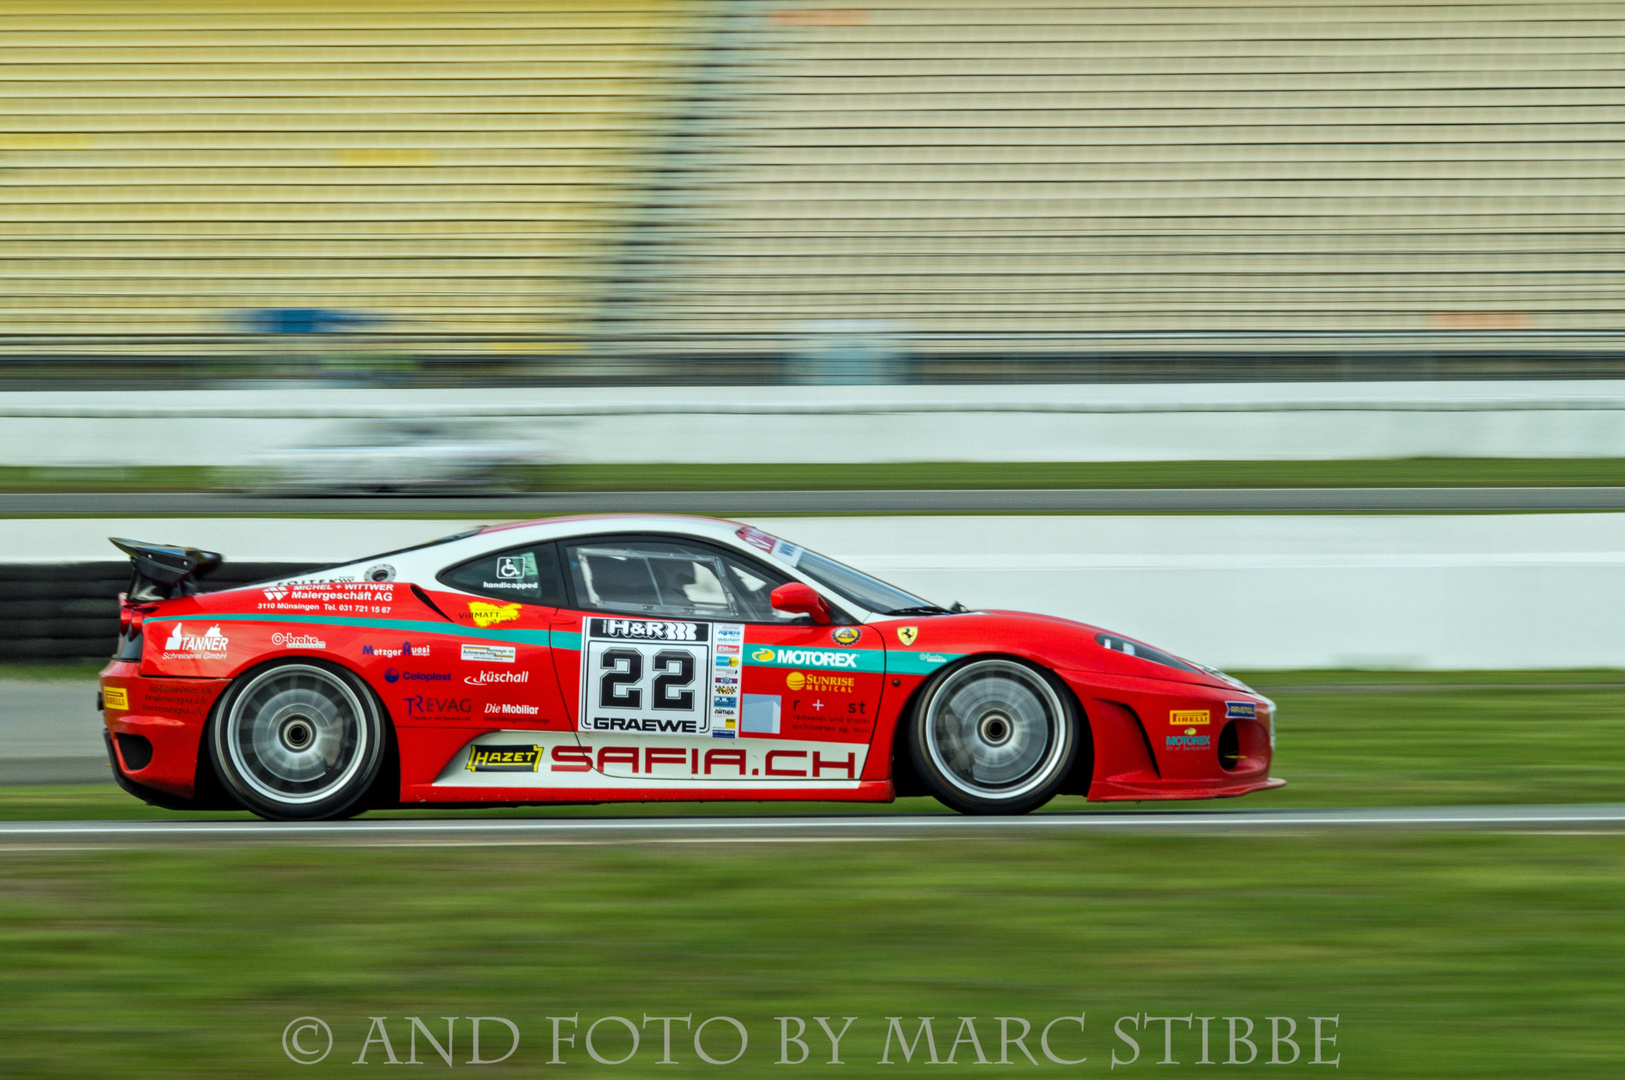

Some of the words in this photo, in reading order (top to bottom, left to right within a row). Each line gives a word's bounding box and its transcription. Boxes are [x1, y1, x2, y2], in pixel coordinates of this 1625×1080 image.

[344, 583, 393, 591] WITTWER
[483, 581, 538, 590] handicapped
[291, 591, 372, 601] Malergeschäft
[374, 592, 393, 601] AG
[277, 602, 319, 611] Münsingen
[324, 603, 337, 611] Tel.
[339, 604, 352, 612] 031
[371, 605, 380, 613] 15
[381, 606, 391, 614] 67
[608, 620, 668, 639] H&R
[182, 636, 228, 650] TANNER
[162, 652, 201, 660] Schreinerei
[203, 652, 227, 660] GmbH
[362, 645, 402, 657] Metzger
[777, 649, 857, 668] MOTOREX
[402, 671, 451, 682] Coloplast
[480, 670, 529, 683] küschall
[599, 647, 696, 712] 22
[806, 674, 854, 686] SUNRISE
[149, 685, 212, 694] holzsteiner.ch
[806, 684, 852, 693] MEDICAL
[145, 693, 207, 705] bodenexpo.ch
[793, 700, 800, 711] r
[812, 699, 824, 711] +
[142, 703, 202, 715] tuerenexpo.ch
[484, 703, 501, 714] Die
[502, 704, 539, 715] Mobiliar
[829, 715, 844, 723] und
[1172, 712, 1208, 722] PIRELLI
[593, 717, 696, 733] GRAEWE
[792, 723, 835, 731] architekten
[852, 726, 870, 734] muri
[1166, 736, 1210, 745] MOTOREX
[474, 752, 535, 766] HAZET
[550, 745, 855, 779] SAFIA.CH
